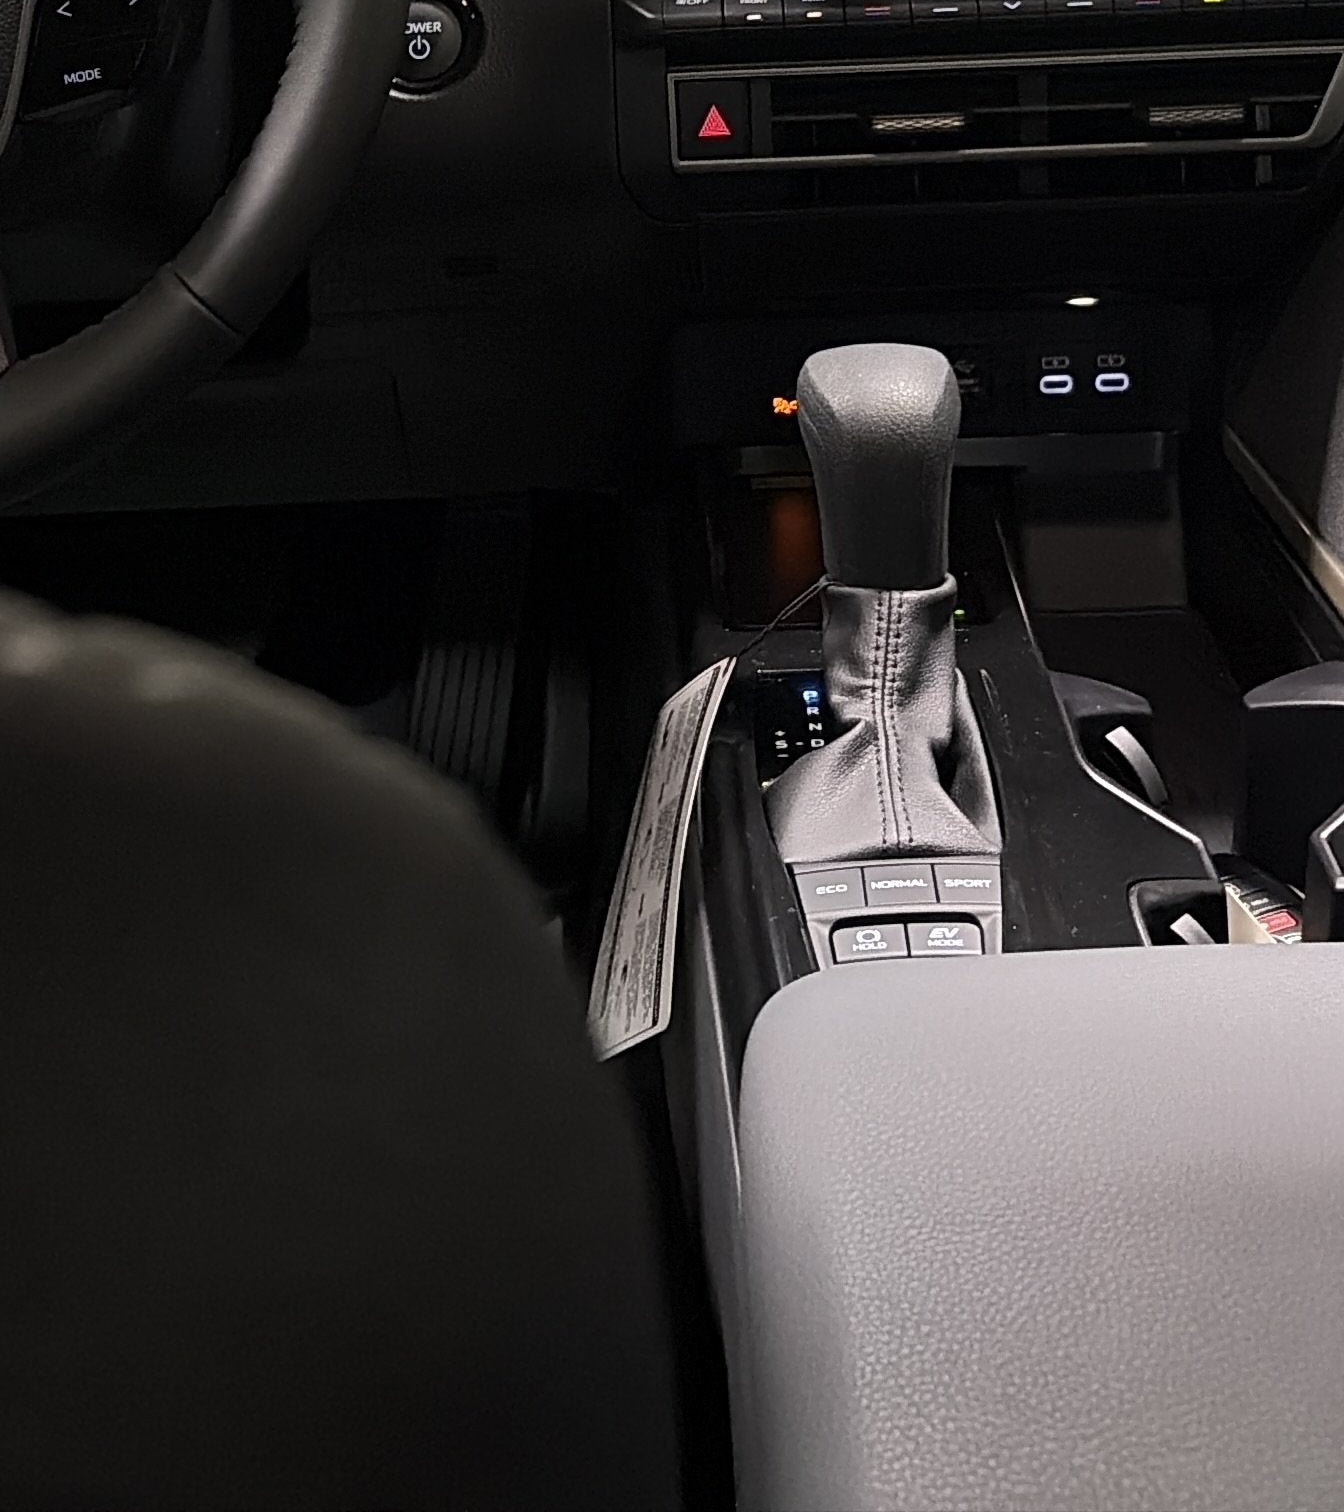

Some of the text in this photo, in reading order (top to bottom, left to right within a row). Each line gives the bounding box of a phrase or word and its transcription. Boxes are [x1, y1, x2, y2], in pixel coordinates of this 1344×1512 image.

[404, 21, 442, 34] OWER
[63, 68, 102, 85] MODE
[803, 690, 818, 703] P
[808, 722, 823, 731] N
[775, 739, 788, 749] S
[810, 738, 825, 748] D
[870, 878, 928, 890] NORMAL
[943, 879, 992, 888] SPORT
[815, 884, 848, 895] ECO
[928, 927, 960, 939] EV
[852, 941, 888, 952] HOLD
[927, 938, 964, 947] MODE
